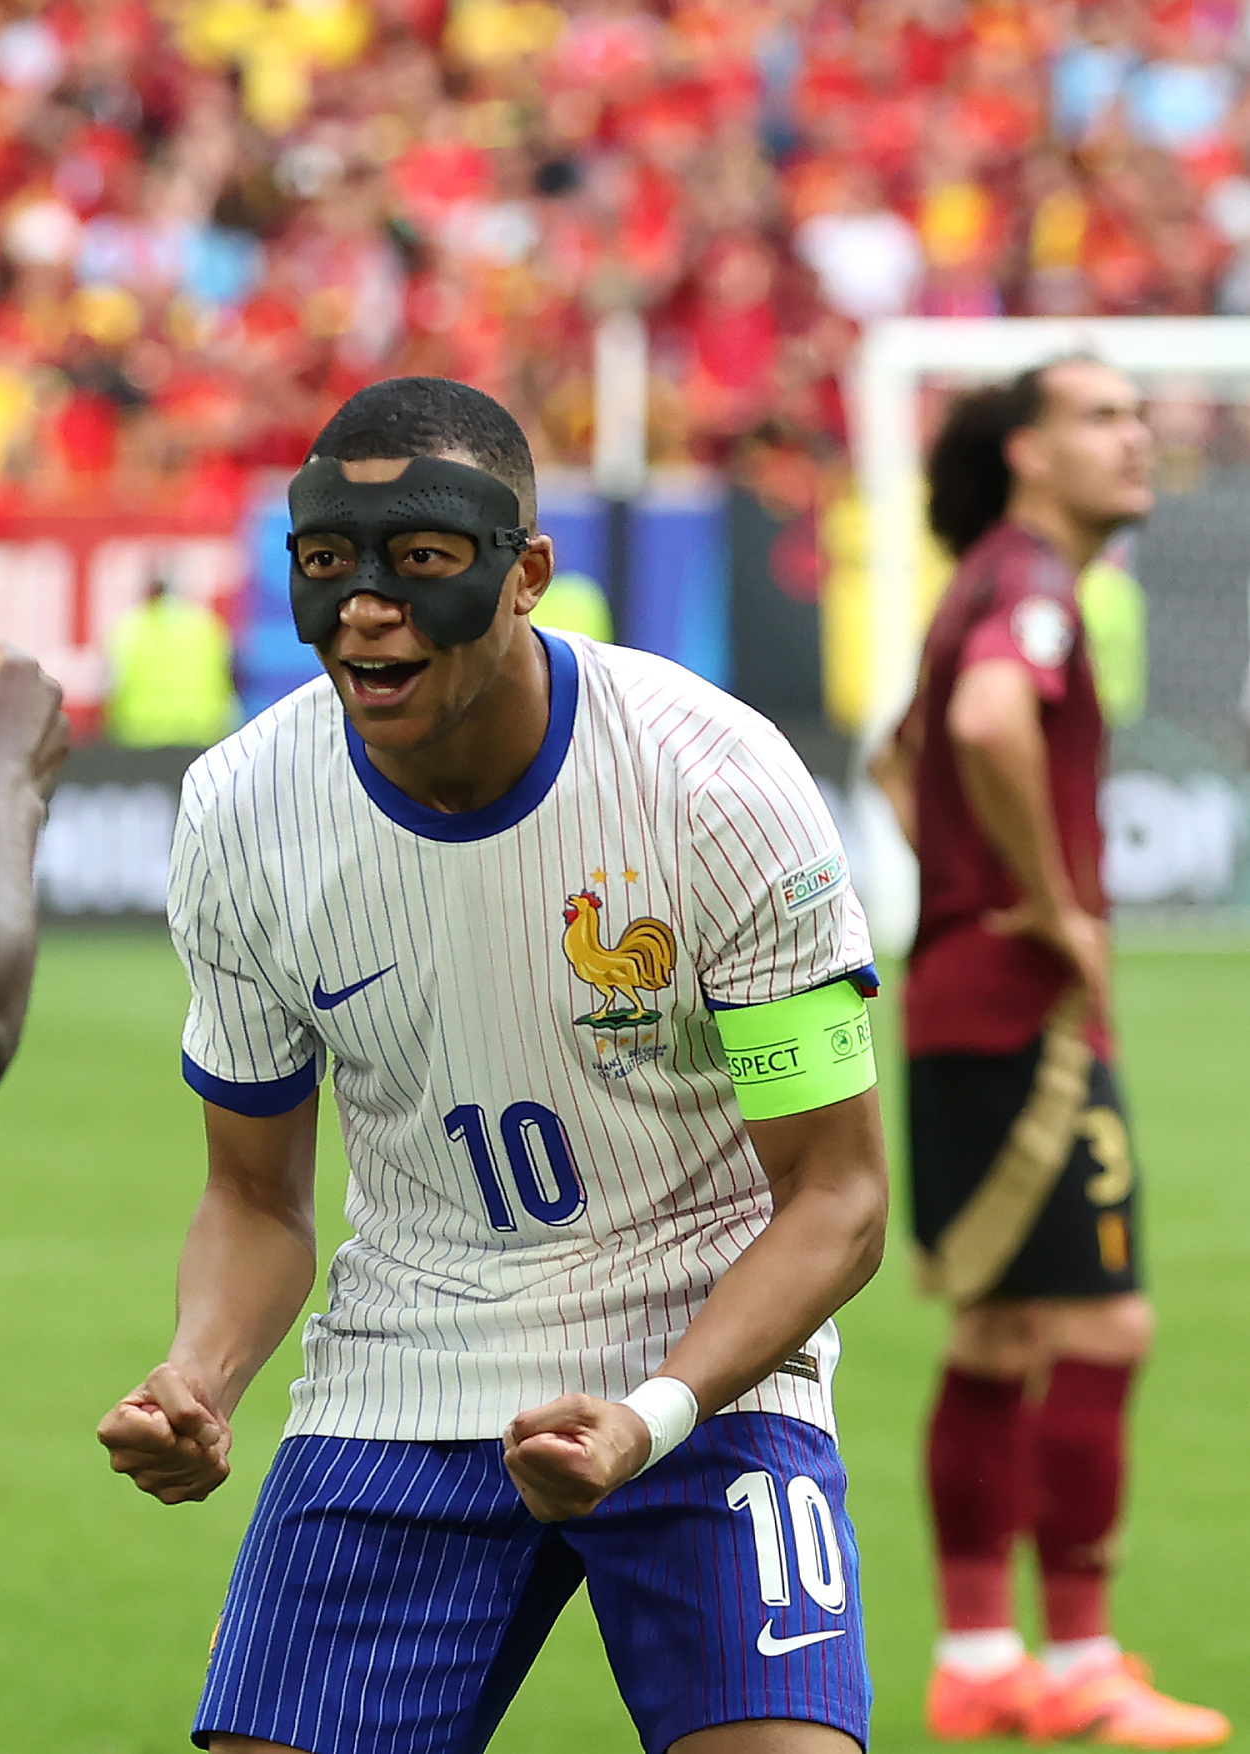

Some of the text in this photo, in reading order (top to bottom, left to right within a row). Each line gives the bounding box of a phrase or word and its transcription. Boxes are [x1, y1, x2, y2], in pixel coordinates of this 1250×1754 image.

[781, 870, 806, 890] UEFA
[443, 1100, 588, 1232] 10
[1083, 1104, 1133, 1208] 3
[725, 1470, 847, 1615] 10
